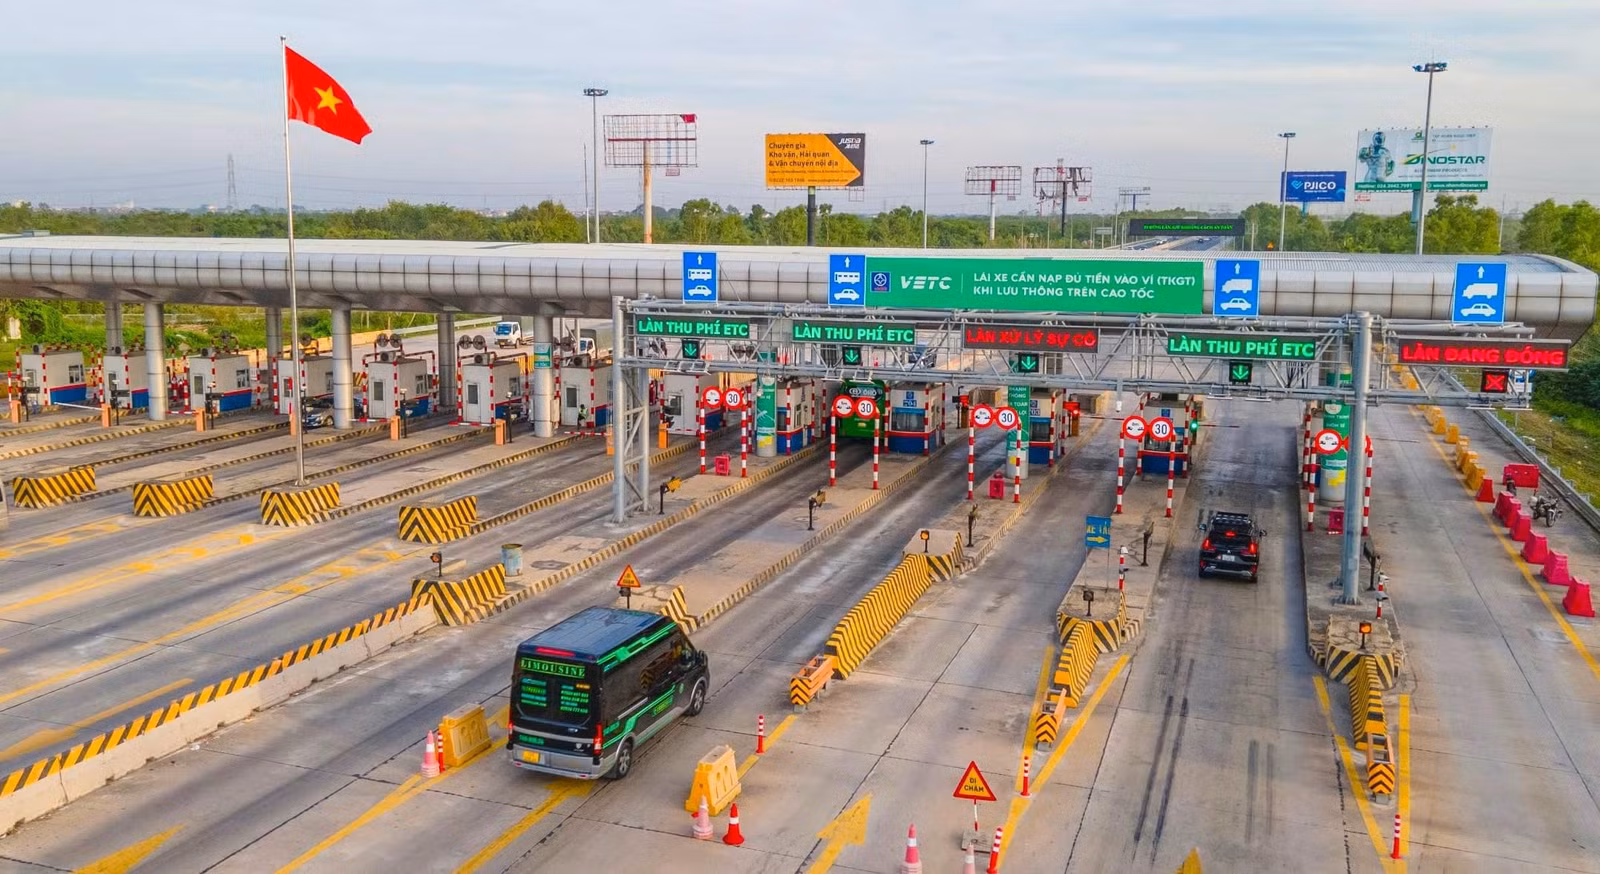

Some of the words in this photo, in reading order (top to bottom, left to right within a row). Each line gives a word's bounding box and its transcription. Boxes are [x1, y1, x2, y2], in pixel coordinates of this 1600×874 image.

[1303, 181, 1337, 190] PJICO
[900, 276, 953, 290] VETC
[973, 271, 991, 282] LÁI
[993, 273, 1008, 282] XE
[1038, 274, 1063, 285] NẠP
[1065, 272, 1082, 283] ĐỦ
[1114, 272, 1139, 285] VÀO
[1142, 273, 1154, 285] VÍ
[1156, 276, 1196, 286] (TKGT)
[973, 286, 993, 295] KHI
[996, 285, 1019, 295] LƯU
[1022, 285, 1064, 297] THÔNG
[1067, 286, 1097, 297] TRÊN
[1101, 288, 1127, 298] CAO
[1130, 286, 1155, 298] TỐC
[638, 317, 664, 332] LÀN
[666, 321, 693, 334] THU
[696, 319, 721, 335] PHÍ
[723, 323, 748, 336] ETC
[794, 322, 822, 339] LÀN
[824, 327, 853, 340] THU
[857, 325, 883, 341] PHÍ
[887, 329, 914, 342] ETC
[966, 326, 996, 343] LÀN
[1023, 329, 1044, 345] LÝ
[1047, 332, 1071, 348] SỰ
[1169, 335, 1202, 353] LÀN
[1206, 340, 1241, 354] THU
[1245, 338, 1278, 355] PHÍ
[1281, 342, 1314, 357] ETC
[1402, 342, 1440, 361] LÀN
[1443, 347, 1500, 363] ĐANG
[1503, 344, 1564, 365] ĐÓNG
[728, 393, 738, 404] 30
[860, 402, 872, 413] 30
[1001, 412, 1013, 423] 30
[1154, 423, 1168, 435] 30
[520, 658, 585, 677] LIMOUSINE
